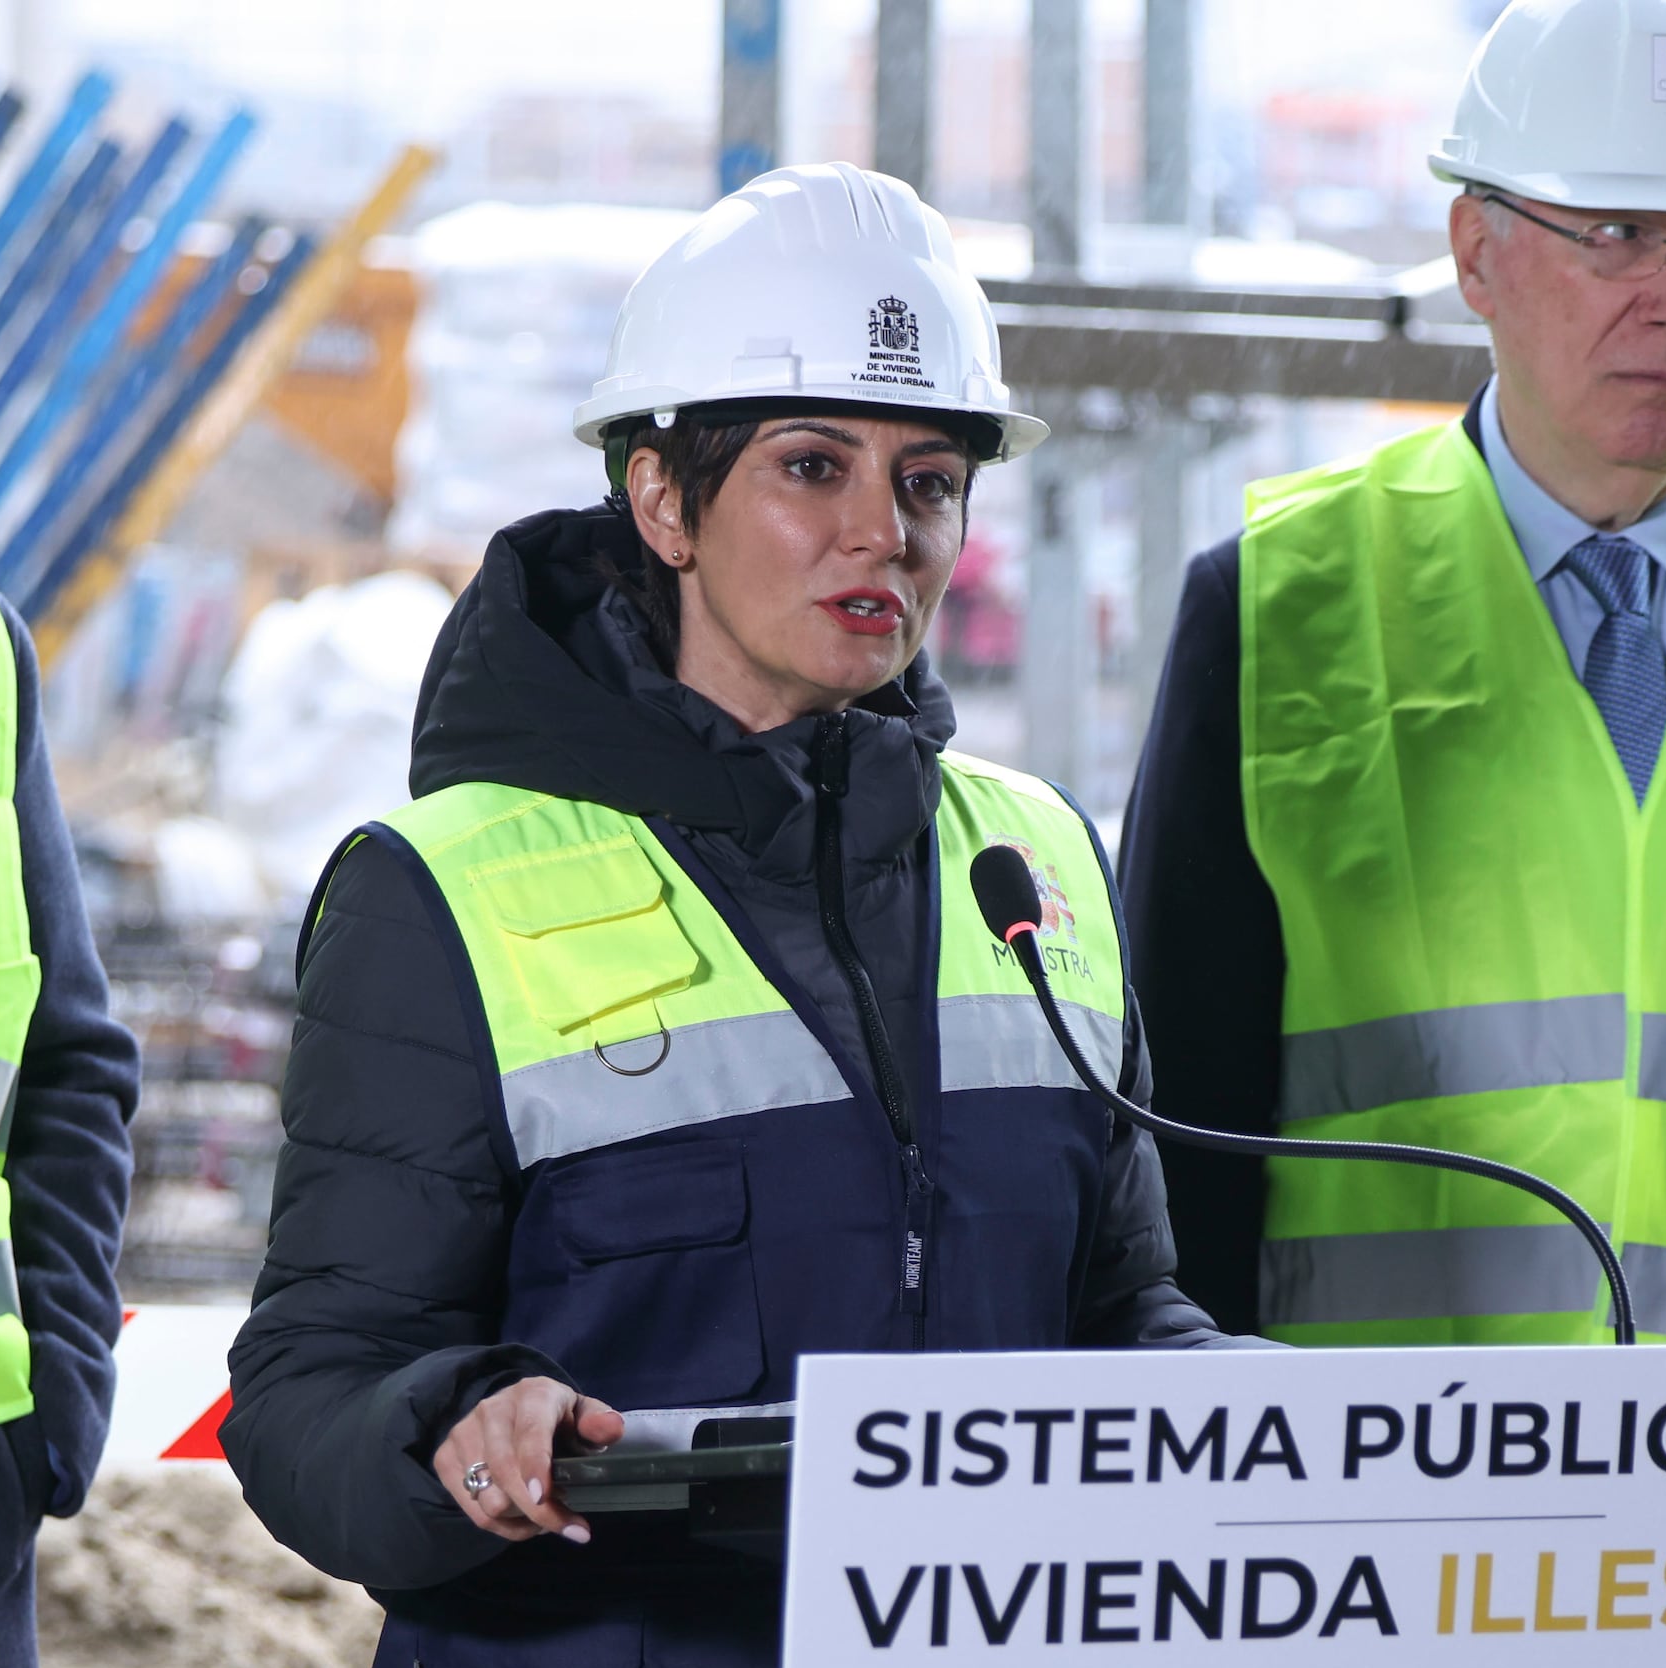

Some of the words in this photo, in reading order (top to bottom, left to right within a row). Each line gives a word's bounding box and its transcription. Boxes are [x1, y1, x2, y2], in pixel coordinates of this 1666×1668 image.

[867, 362, 880, 371] DE
[882, 364, 923, 376] VIVIENDA
[869, 351, 921, 364] MINISTERIO
[851, 373, 857, 381] Y
[859, 374, 899, 384] AGENDA
[900, 377, 935, 389] URBANA
[991, 943, 1095, 982] MISTRA
[852, 1405, 1308, 1489] SISTEMA
[843, 1555, 1400, 1648] VIVIENDA
